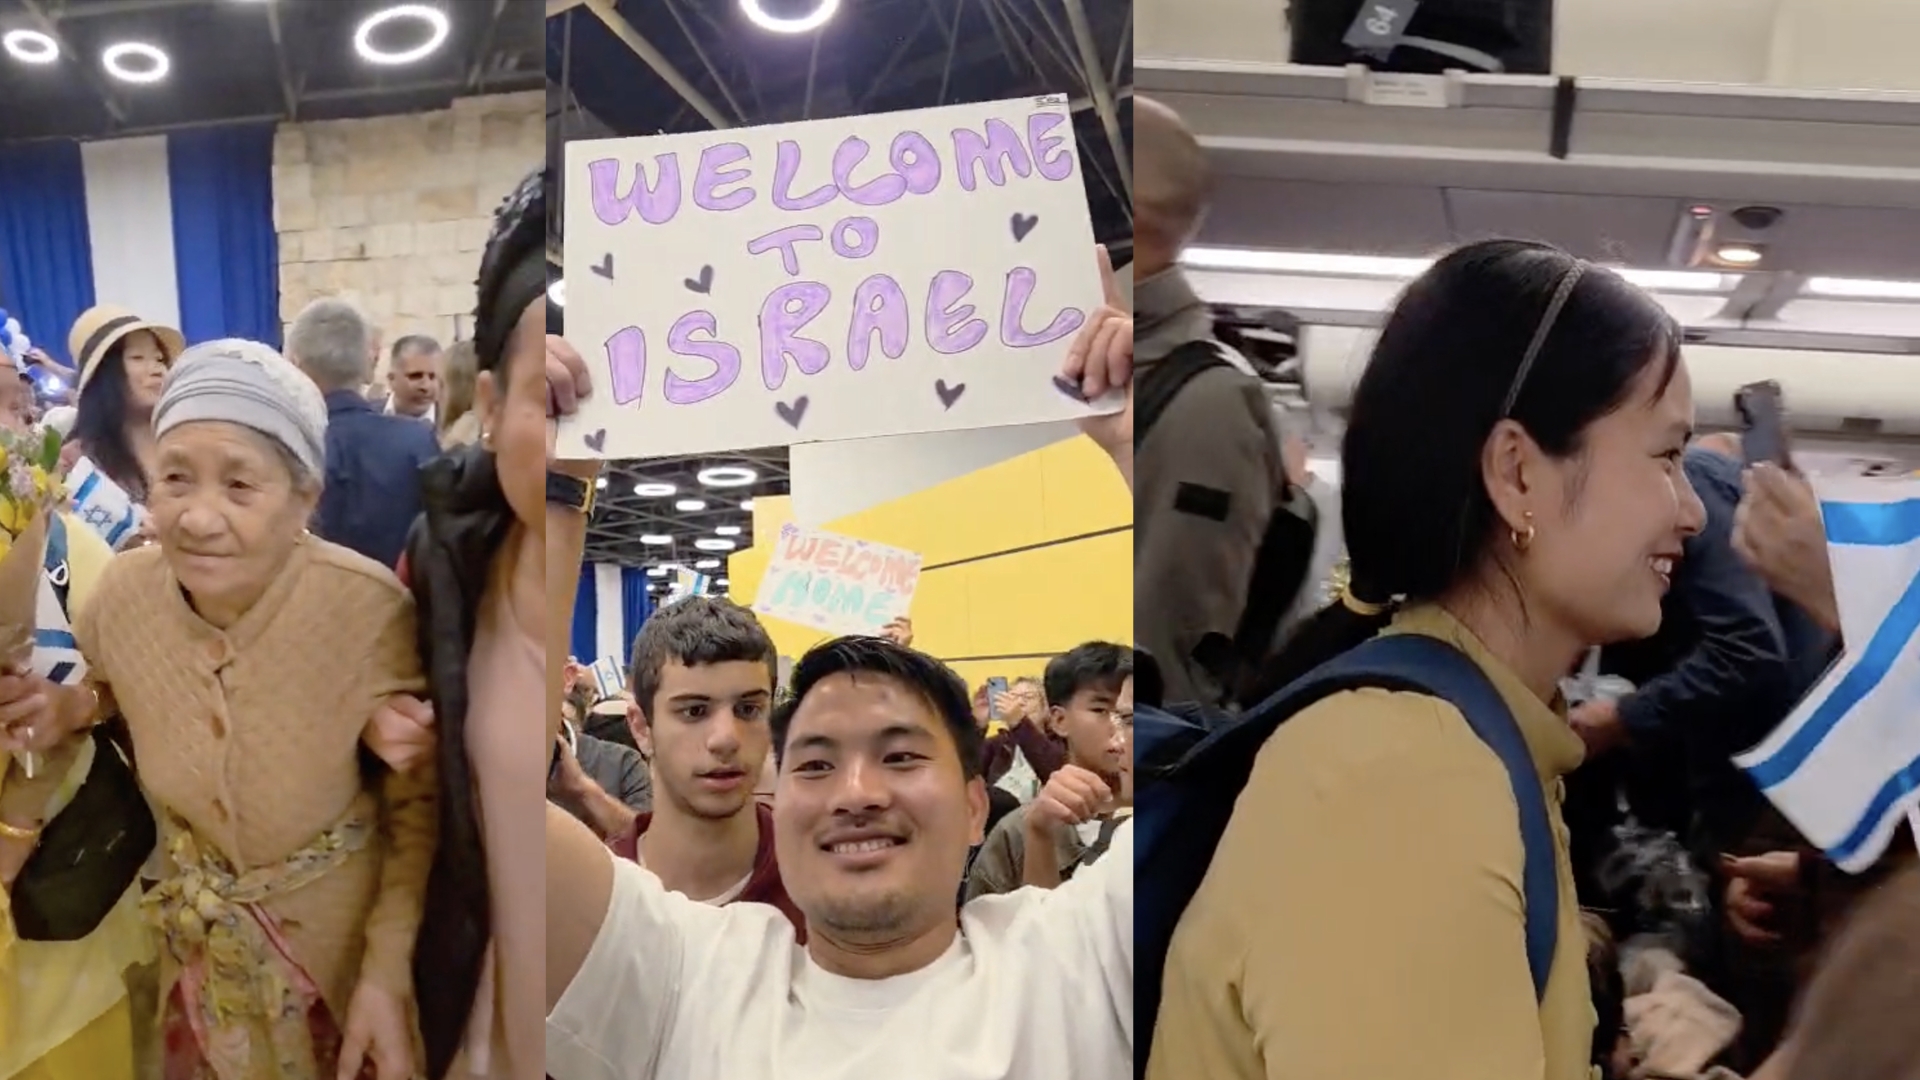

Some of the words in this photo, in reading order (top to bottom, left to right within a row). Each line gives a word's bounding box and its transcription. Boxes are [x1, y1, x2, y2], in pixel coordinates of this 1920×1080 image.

[1366, 5, 1399, 36] 64
[588, 112, 1075, 226] WELCOME
[747, 216, 879, 276] TO
[604, 266, 1085, 409] ISRAEL
[784, 534, 916, 595] WELCOME
[770, 570, 895, 625] HOME
